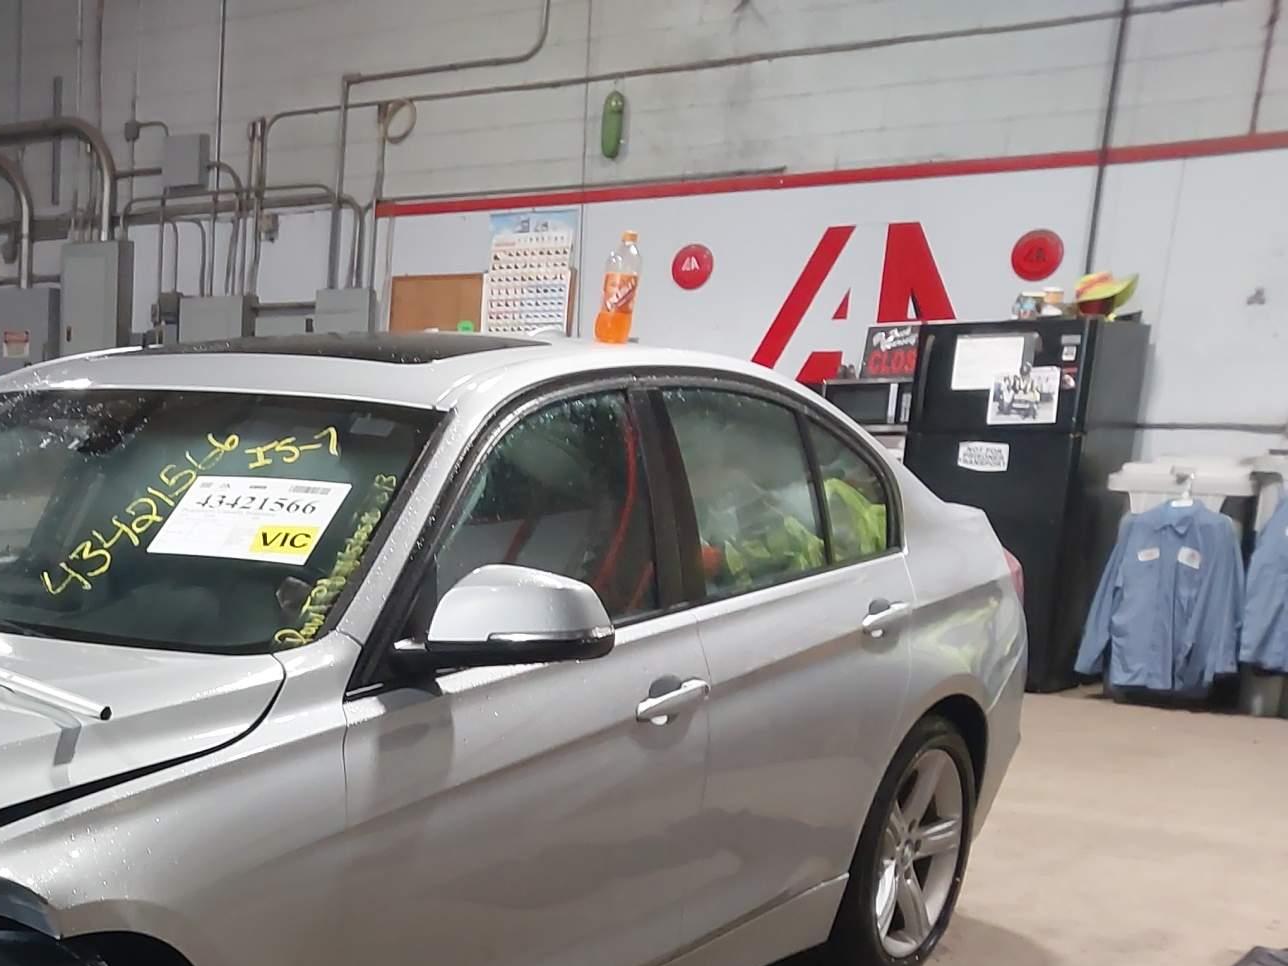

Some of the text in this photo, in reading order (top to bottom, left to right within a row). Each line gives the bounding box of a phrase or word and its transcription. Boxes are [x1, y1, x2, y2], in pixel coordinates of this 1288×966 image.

[40, 432, 240, 595] 43421566
[195, 493, 317, 516] 43421566
[261, 531, 312, 549] VIC
